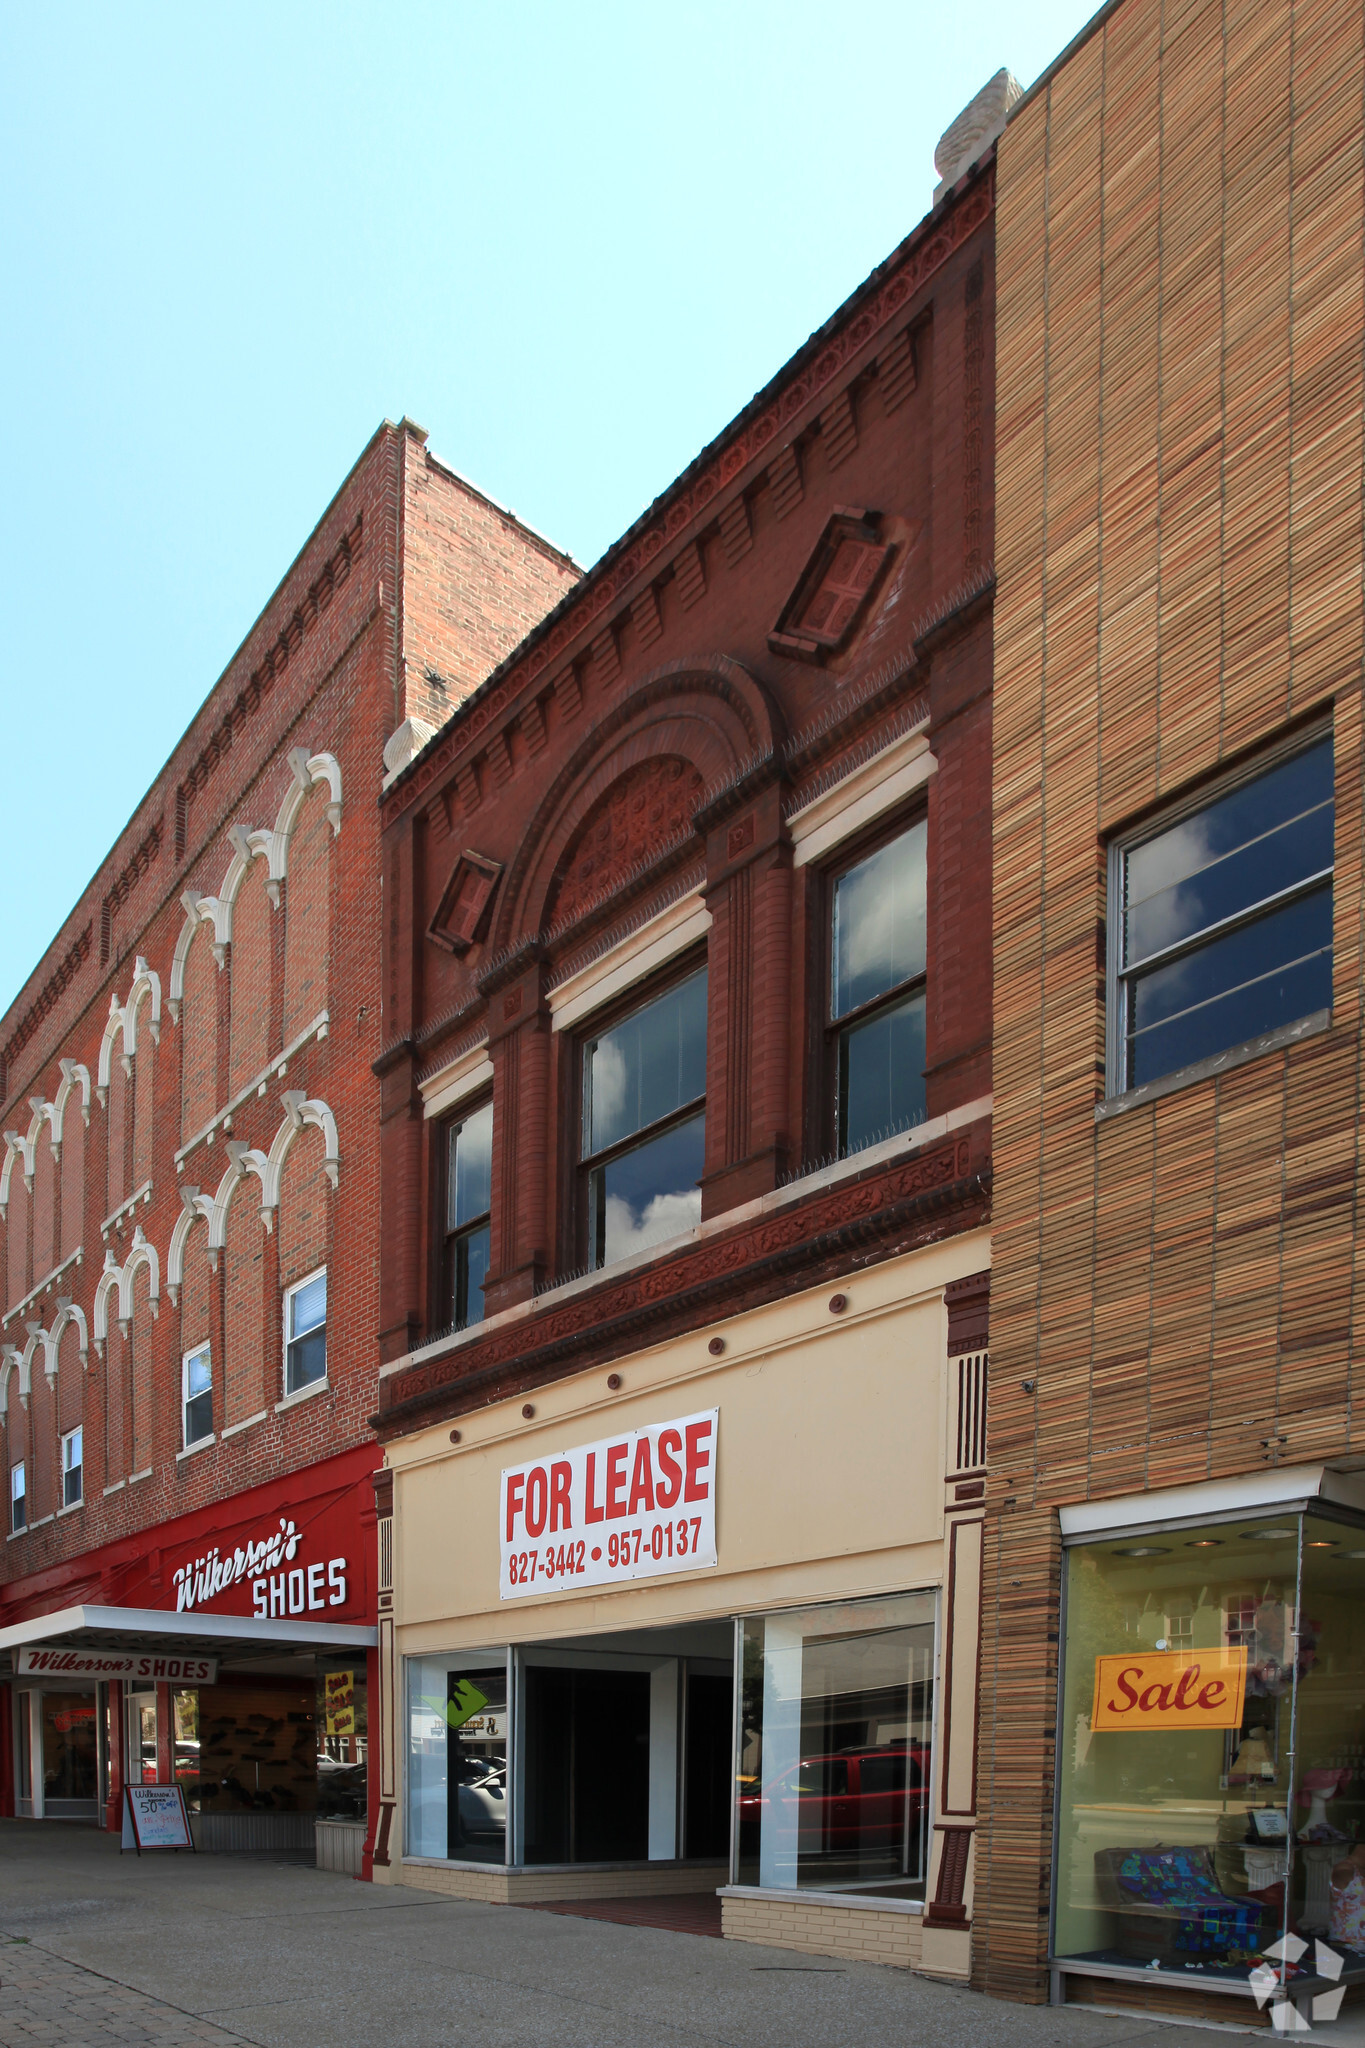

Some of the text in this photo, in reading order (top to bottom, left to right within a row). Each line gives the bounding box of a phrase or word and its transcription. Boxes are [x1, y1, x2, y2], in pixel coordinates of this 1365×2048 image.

[506, 1420, 712, 1543] FOR LEASE
[173, 1518, 303, 1612] Wilkerson's
[509, 1516, 702, 1586] 827-3442 957-0137
[253, 1557, 347, 1619] SHOES
[28, 1651, 210, 1679] Wilkerson's SHOES
[1107, 1664, 1227, 1713] Sale
